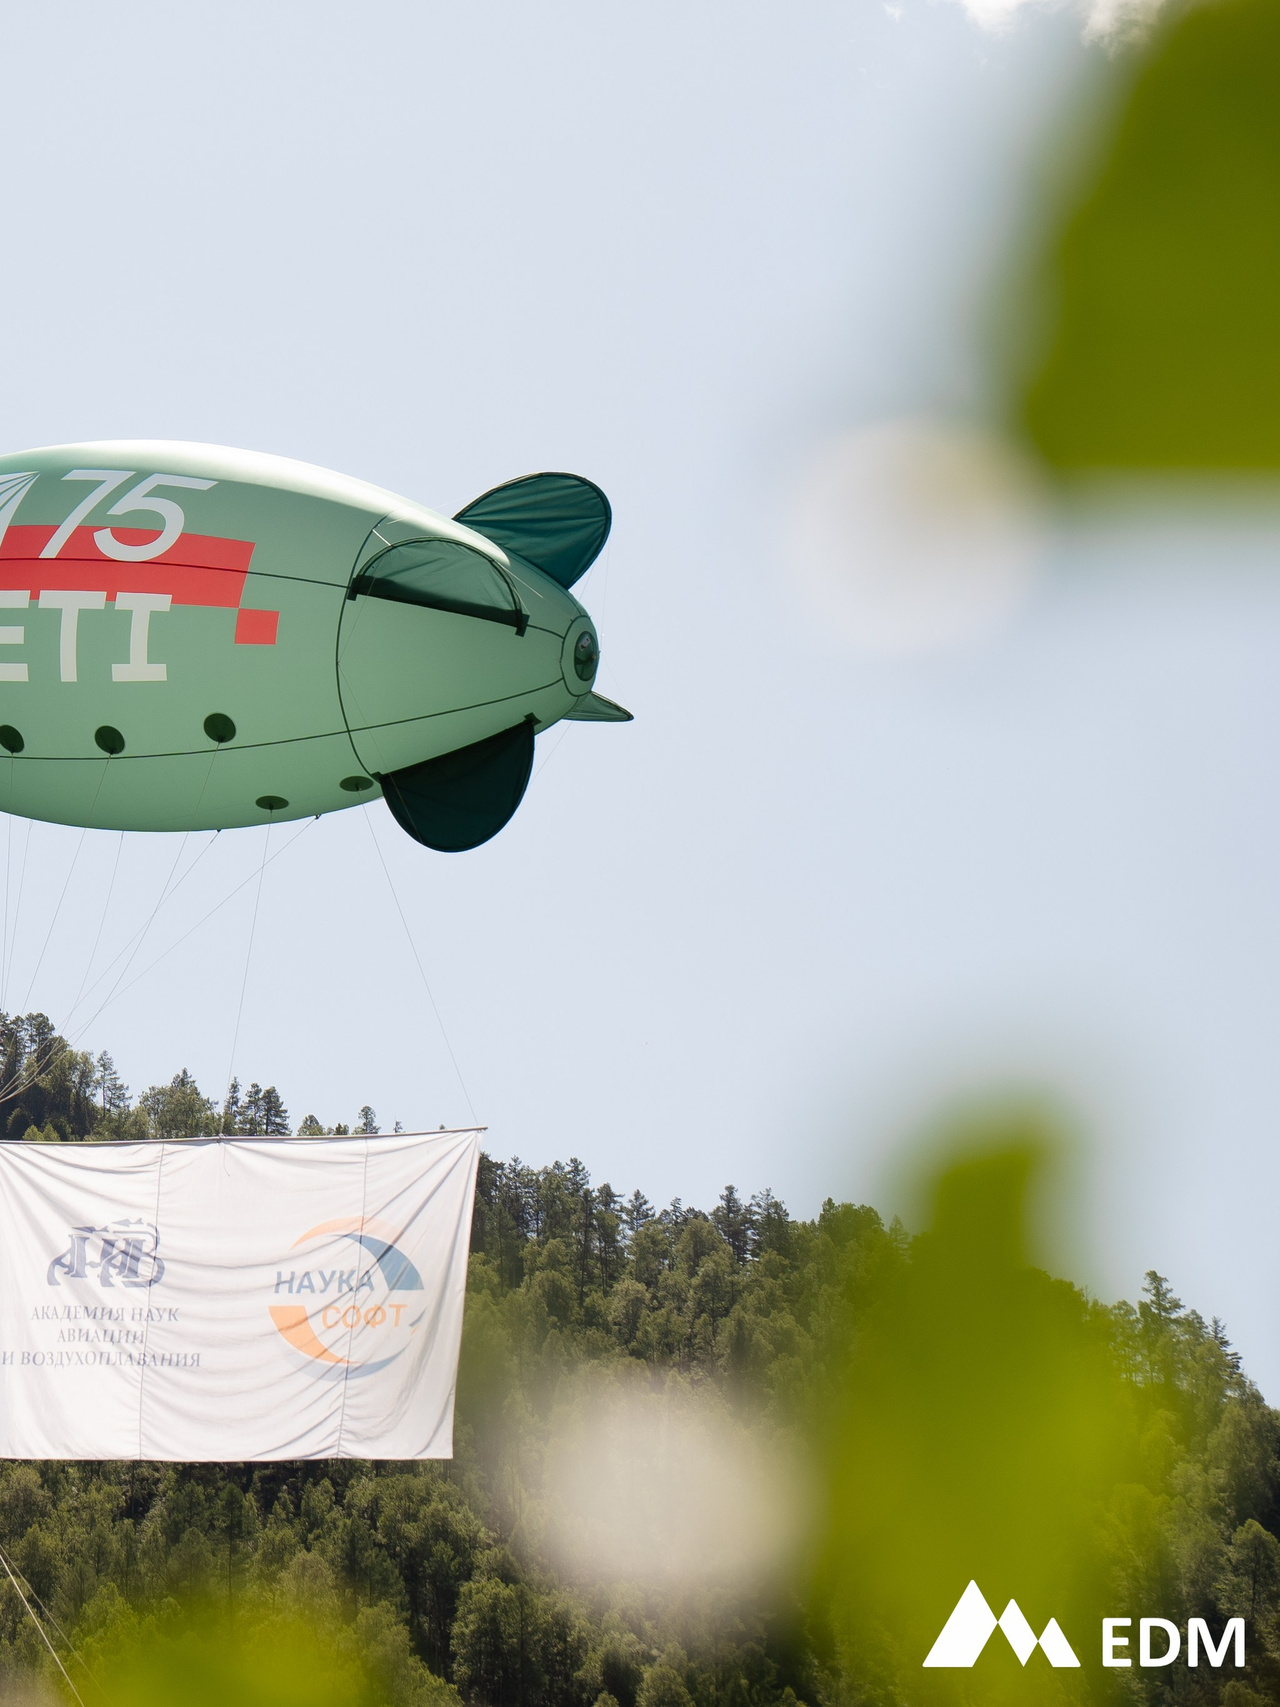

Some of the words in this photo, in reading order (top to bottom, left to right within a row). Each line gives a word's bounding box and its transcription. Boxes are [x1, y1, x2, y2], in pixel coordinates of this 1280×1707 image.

[39, 469, 217, 562] 75
[274, 1270, 375, 1294] НАУКА
[31, 1304, 125, 1323] АКАДЕМИЯ
[131, 1306, 180, 1323] НАУК
[321, 1303, 408, 1330] СОФТ
[57, 1328, 146, 1345] АВИАЦИИ
[1, 1351, 14, 1366] И
[20, 1350, 202, 1369] ВОЗДУХОПЛАВАНИЯ
